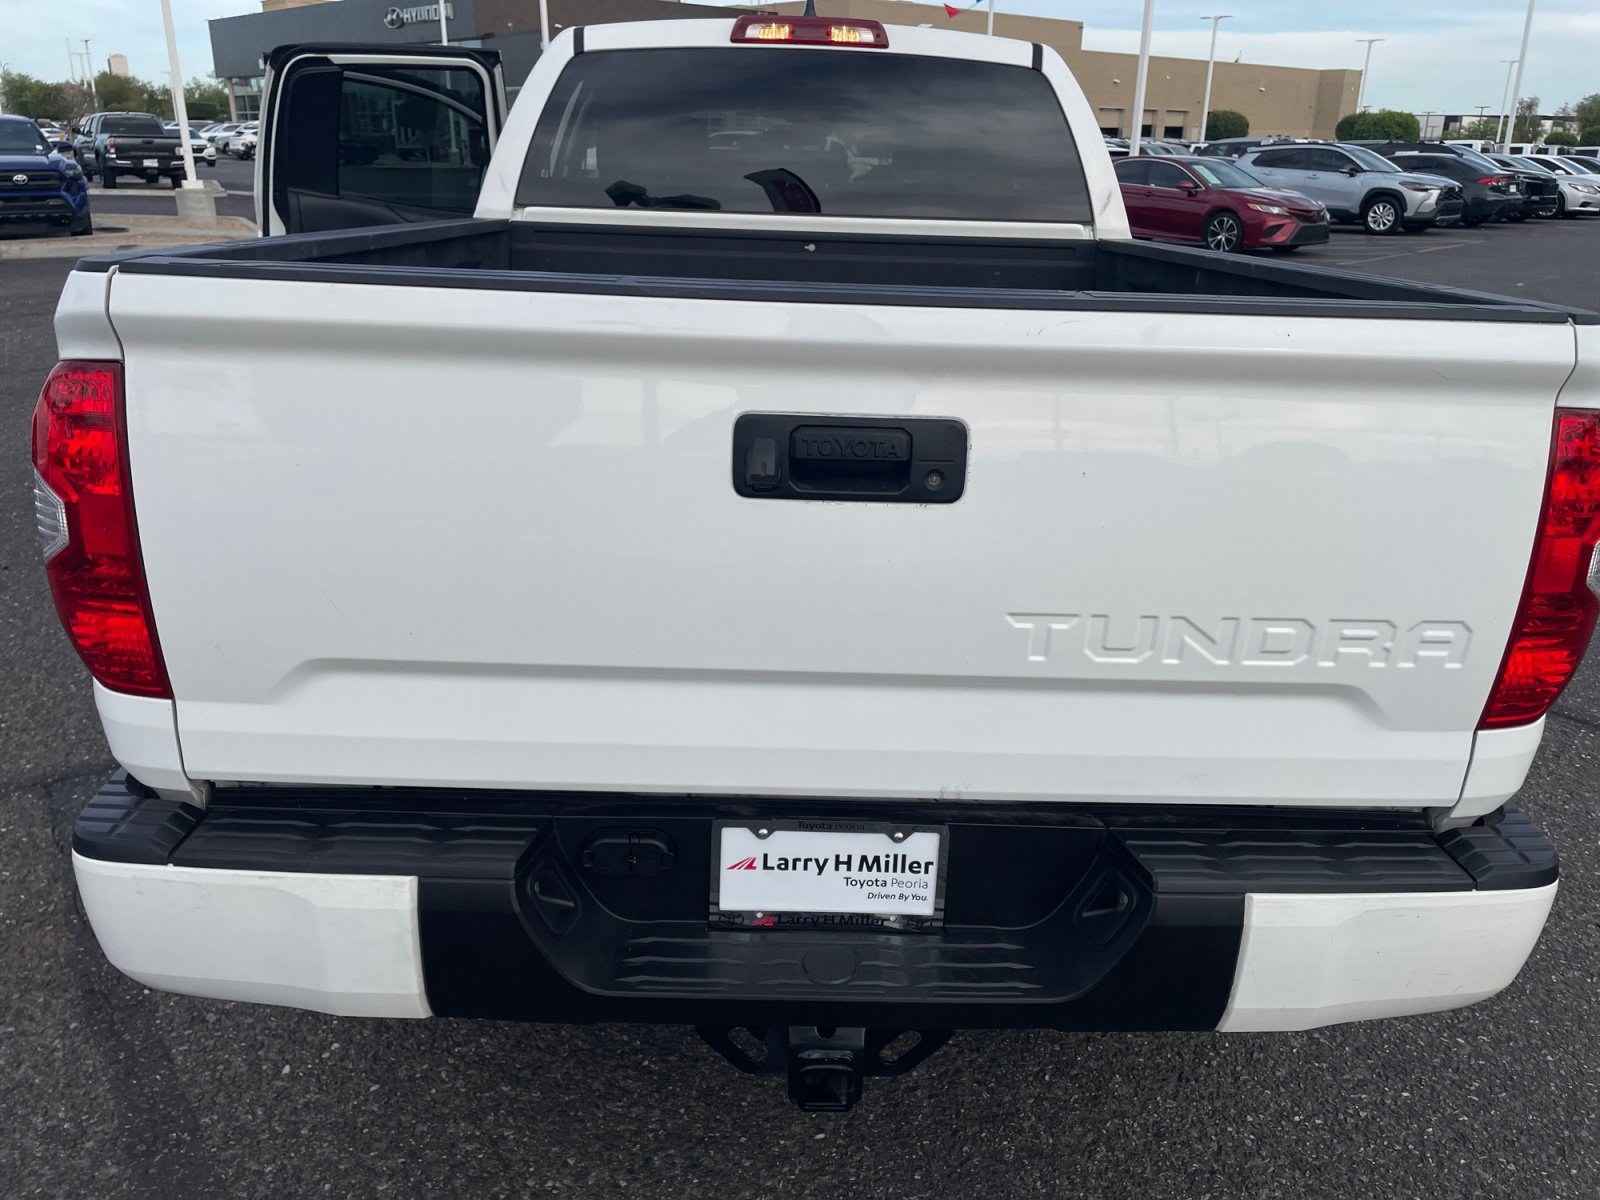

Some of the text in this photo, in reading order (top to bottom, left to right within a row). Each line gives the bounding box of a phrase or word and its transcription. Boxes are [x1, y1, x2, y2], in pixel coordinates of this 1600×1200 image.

[801, 438, 900, 459] TOYOTA
[1005, 612, 1474, 669] TUNDRA
[797, 821, 832, 831] Toyota
[762, 853, 934, 876] Larry H Miller
[843, 877, 929, 889] Toyota Peoria
[867, 892, 896, 900] Driven
[898, 893, 910, 902] By
[777, 914, 886, 927] Larry H Miller
